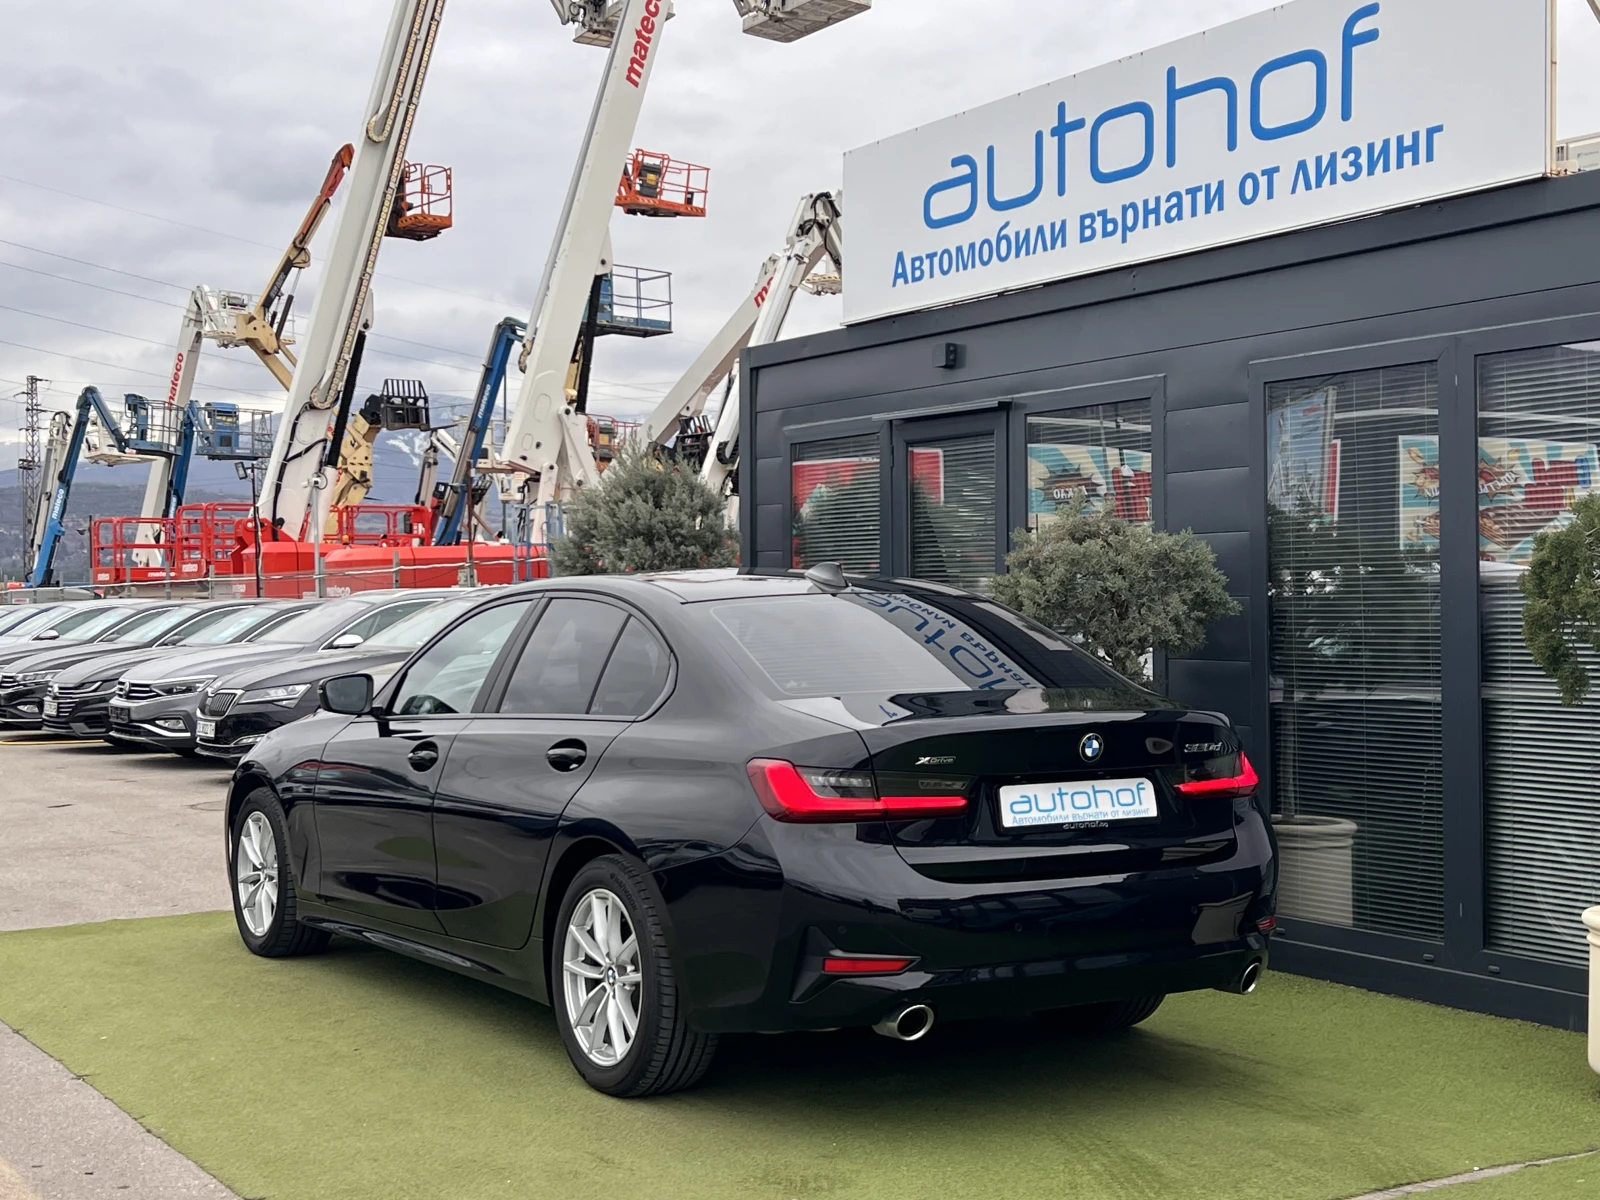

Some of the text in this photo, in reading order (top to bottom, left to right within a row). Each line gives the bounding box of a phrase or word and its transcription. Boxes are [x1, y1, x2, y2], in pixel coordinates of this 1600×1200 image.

[626, 0, 663, 88] matec
[923, 2, 1380, 229] autohof
[892, 124, 1444, 288] Автомобили върнати от лизинг
[1010, 782, 1146, 814] autohof
[1012, 813, 1069, 825] Автомобили
[1111, 809, 1120, 818] от
[1122, 808, 1150, 817] лизинг
